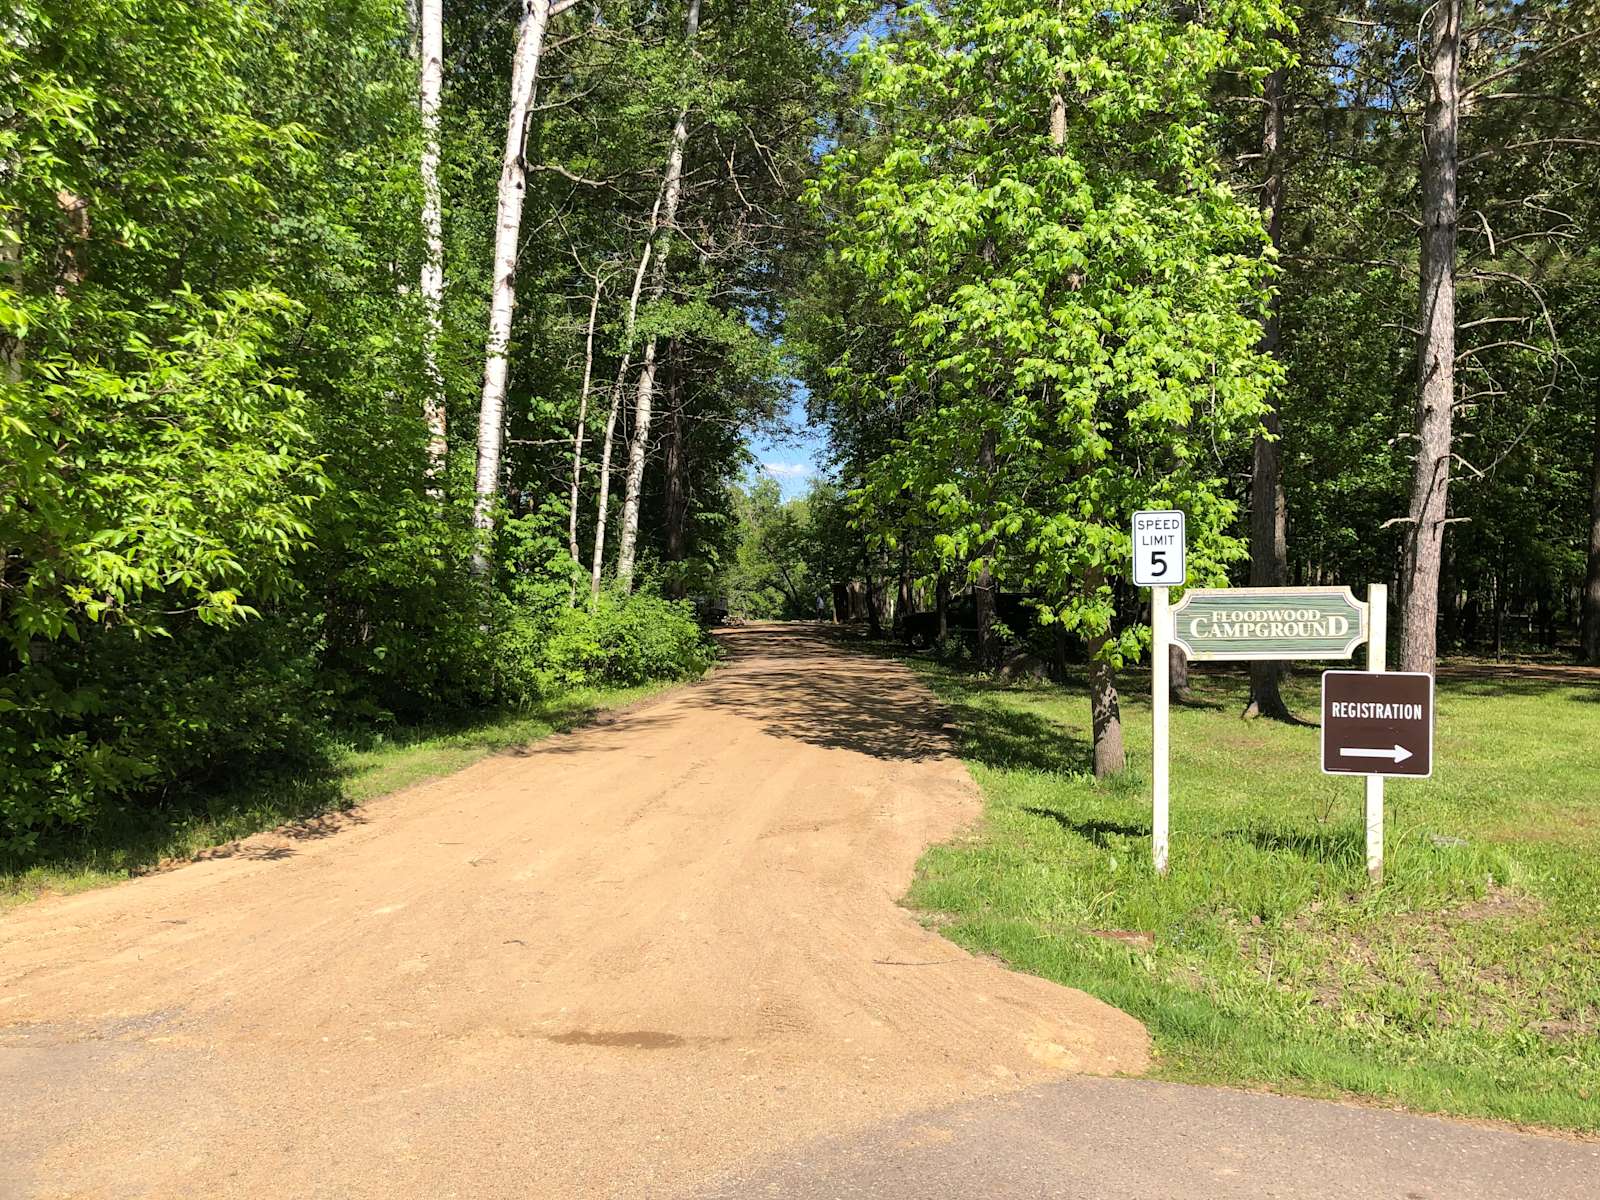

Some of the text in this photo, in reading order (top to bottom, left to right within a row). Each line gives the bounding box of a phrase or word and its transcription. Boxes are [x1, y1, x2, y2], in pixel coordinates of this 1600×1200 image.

[1138, 519, 1180, 530] SPEED
[1142, 535, 1175, 546] LIMIT
[1151, 551, 1168, 577] 5
[1211, 609, 1321, 623] FLOODWOOD
[1189, 615, 1349, 639] CAMPGROUND
[1331, 701, 1422, 720] REGISTRATION
